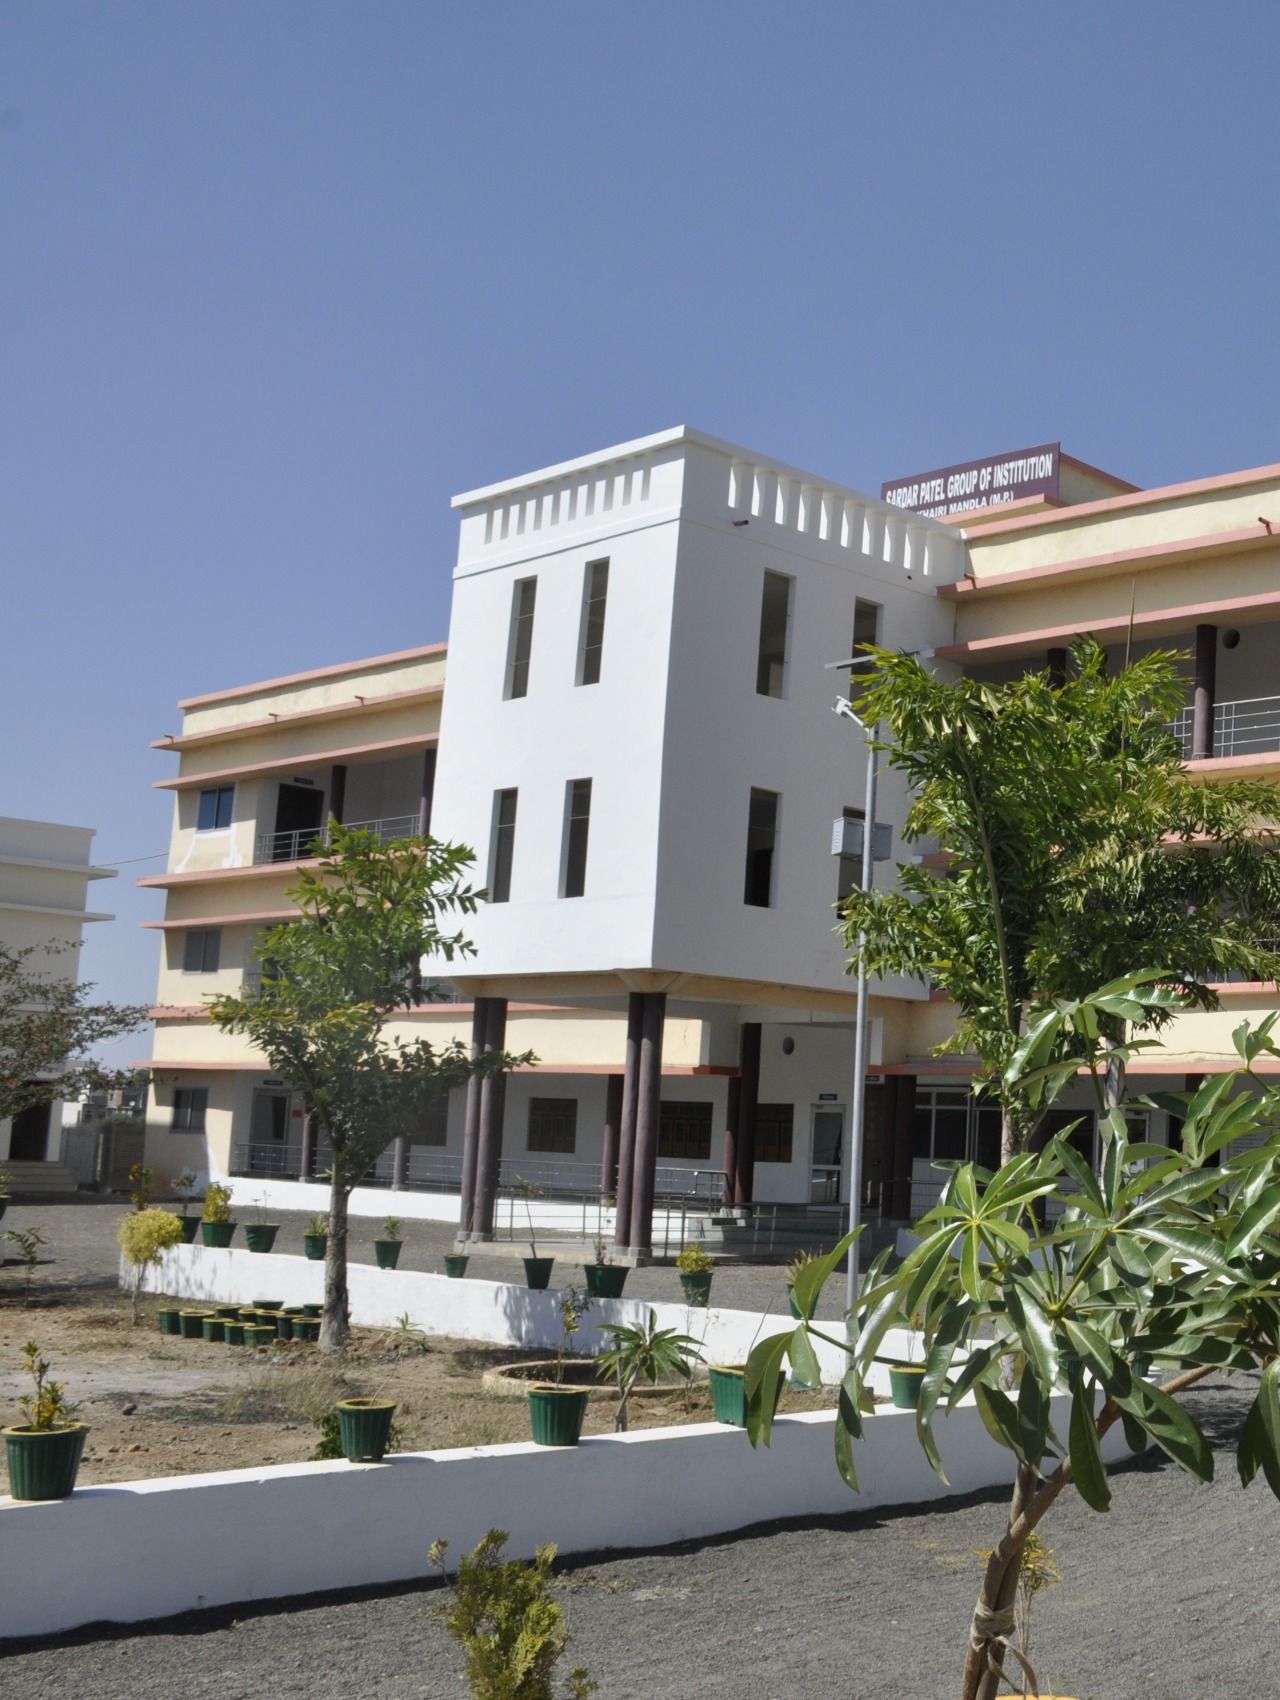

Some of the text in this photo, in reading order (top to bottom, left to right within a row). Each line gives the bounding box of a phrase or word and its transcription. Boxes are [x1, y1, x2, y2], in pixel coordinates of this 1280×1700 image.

[886, 453, 1053, 509] SARDAR PATEL GROUP OF INSTITUTION
[949, 496, 988, 515] MANDLA
